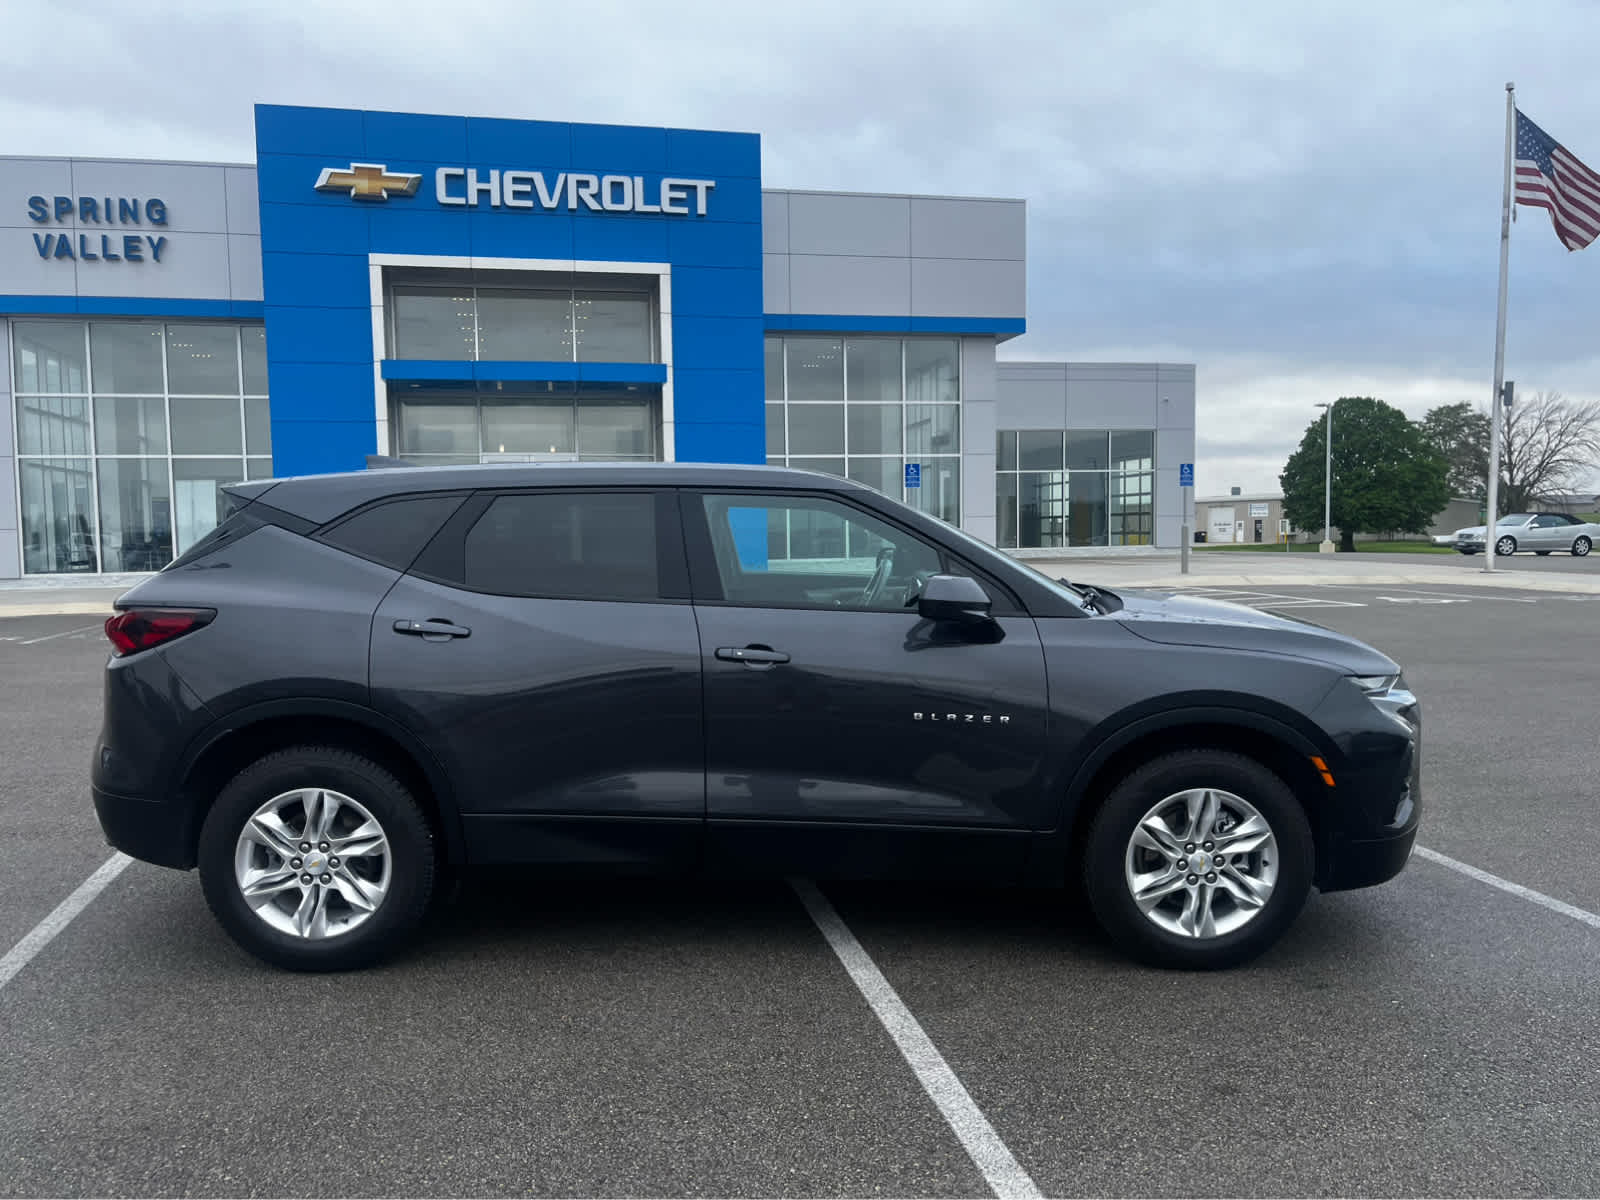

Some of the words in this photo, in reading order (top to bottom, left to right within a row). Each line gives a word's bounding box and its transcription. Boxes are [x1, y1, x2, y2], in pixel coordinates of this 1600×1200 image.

[435, 167, 716, 216] CHEVROLET
[27, 195, 168, 225] SPRING
[32, 233, 166, 263] VALLEY
[913, 712, 1010, 724] BLAZER
